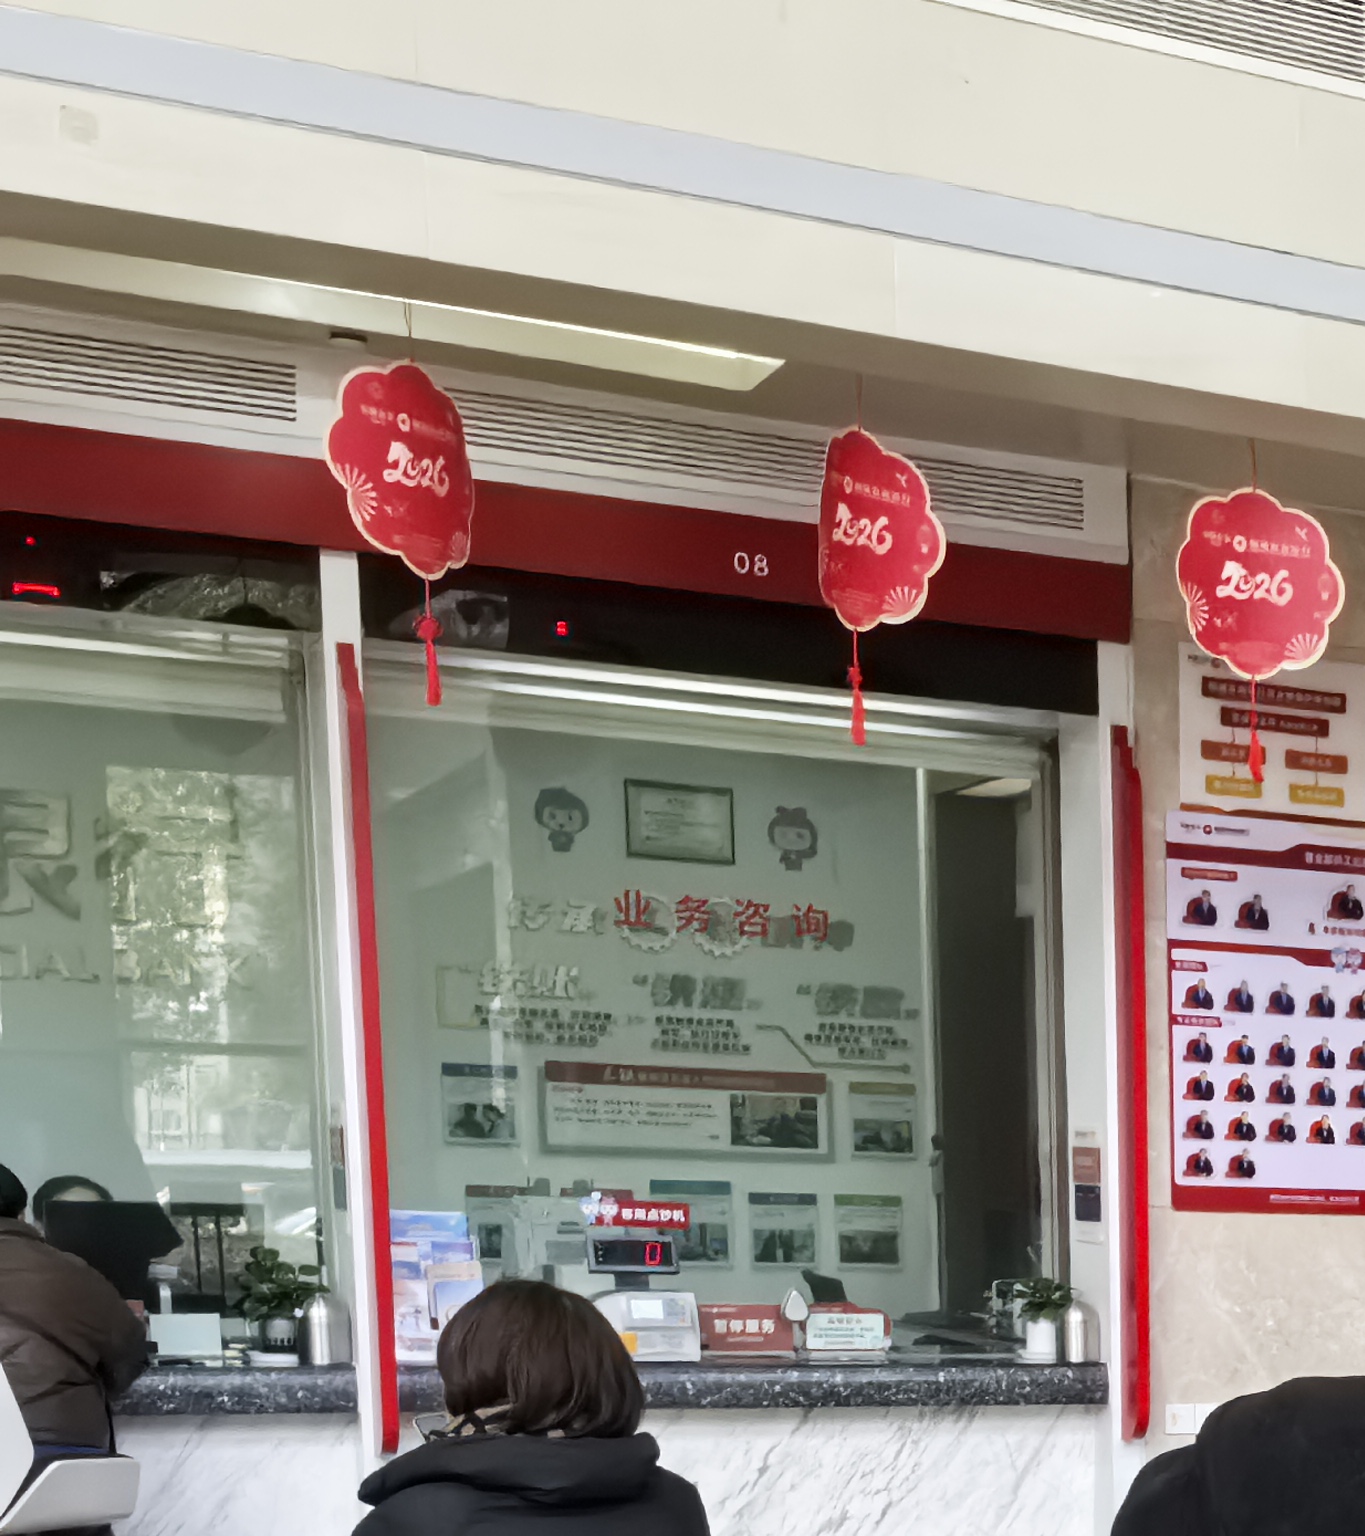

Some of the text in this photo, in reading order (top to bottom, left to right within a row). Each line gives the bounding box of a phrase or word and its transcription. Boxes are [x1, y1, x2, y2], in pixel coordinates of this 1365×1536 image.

[383, 441, 449, 497] 2026
[832, 501, 893, 555] 2026
[733, 552, 769, 576] 08
[1215, 560, 1294, 607] 2026
[614, 889, 828, 941] 业务咨询
[645, 1241, 663, 1266] 0
